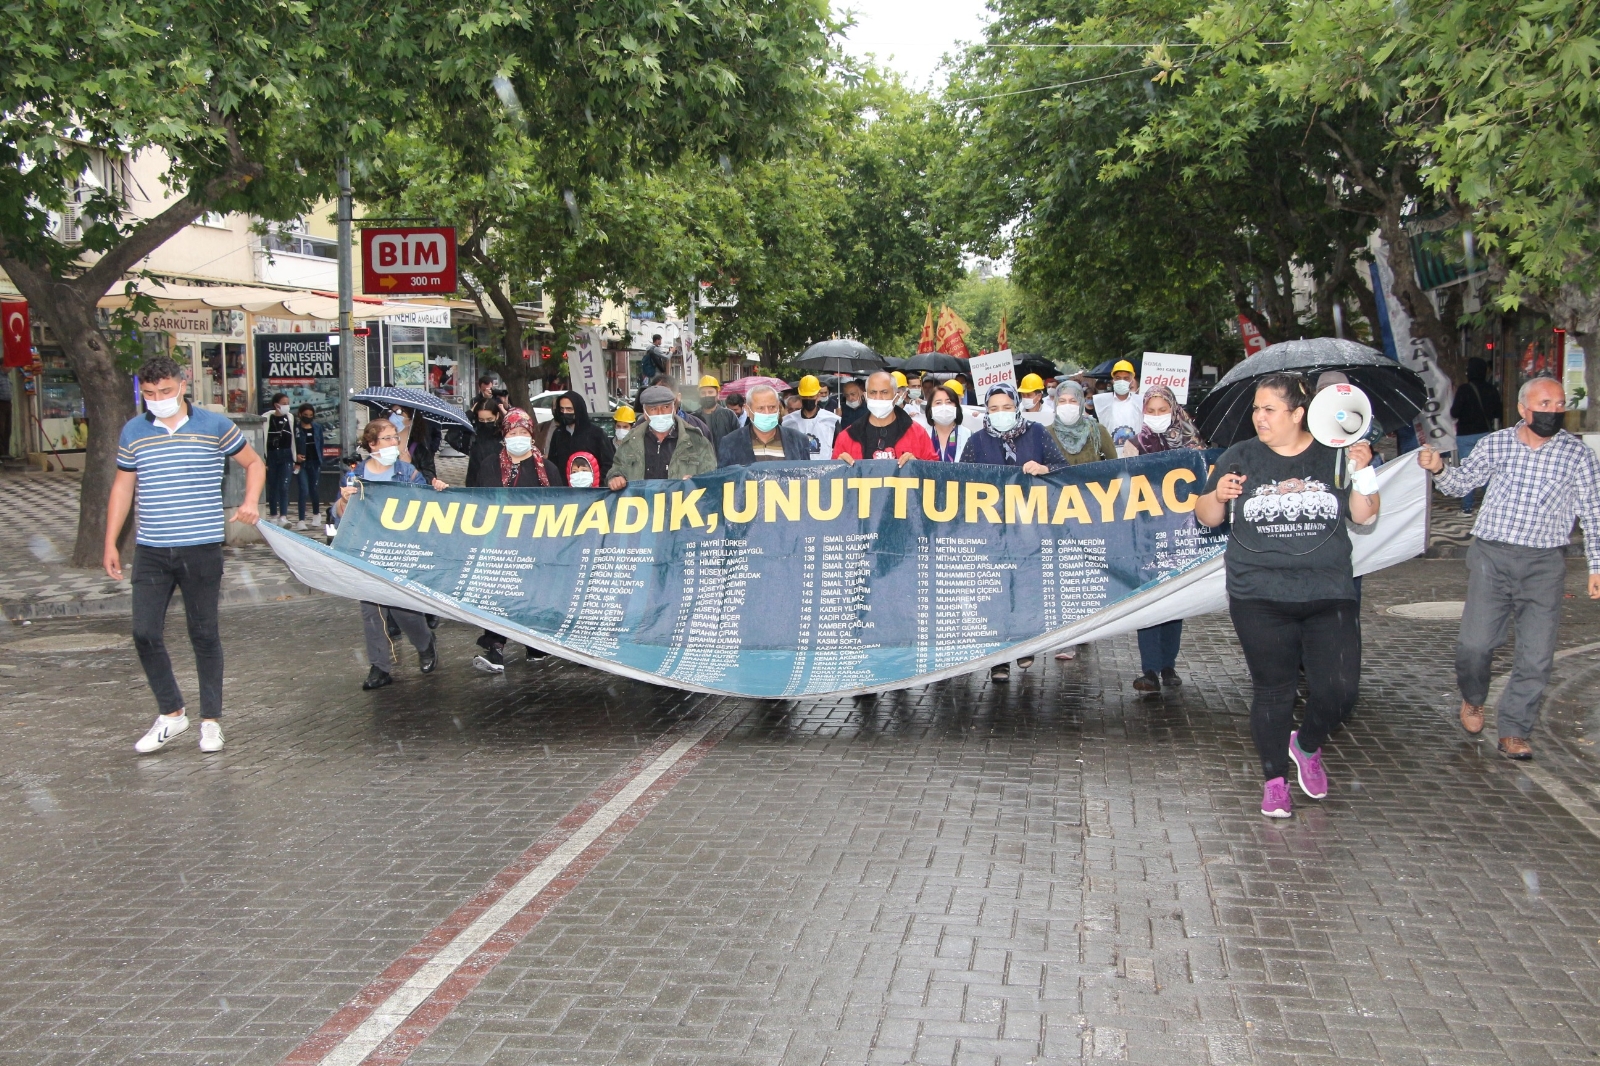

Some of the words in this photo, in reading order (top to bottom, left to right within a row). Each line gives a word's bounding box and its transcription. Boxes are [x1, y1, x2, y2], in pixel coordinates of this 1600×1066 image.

[410, 276, 427, 286] 300
[142, 316, 150, 327] &
[154, 316, 208, 330] ŞARKÜTERİ
[268, 342, 282, 352] BU
[284, 342, 332, 352] PROJELER
[978, 369, 1012, 386] adalet
[1145, 374, 1186, 387] adalet
[380, 487, 718, 538] UNUTMADIK,
[722, 462, 1216, 526] UNUTTURMAYAC
[1174, 527, 1191, 536] RUHİ
[1192, 526, 1211, 535] DAĞLI
[1256, 523, 1302, 533] MYSTERIOUS
[1304, 522, 1326, 530] MINDS
[701, 539, 719, 547] HAYRİ
[1175, 536, 1208, 546] SADETTİN
[1209, 534, 1230, 542] YILMA
[371, 547, 404, 555] ABDULLAH
[405, 548, 434, 557] ÖZDEMİR
[595, 547, 625, 555] ERDOĞAN
[738, 547, 764, 555] BAYGÜL
[977, 571, 1000, 579] ÇAĞAN
[1085, 569, 1100, 577] ŞAM
[611, 580, 644, 588] ALTUNTAŞ
[1082, 576, 1109, 584] AFACAN
[692, 613, 719, 621] İBRAHİM
[848, 619, 875, 630] ÇAĞLAR
[690, 628, 717, 636] İBRAHİM
